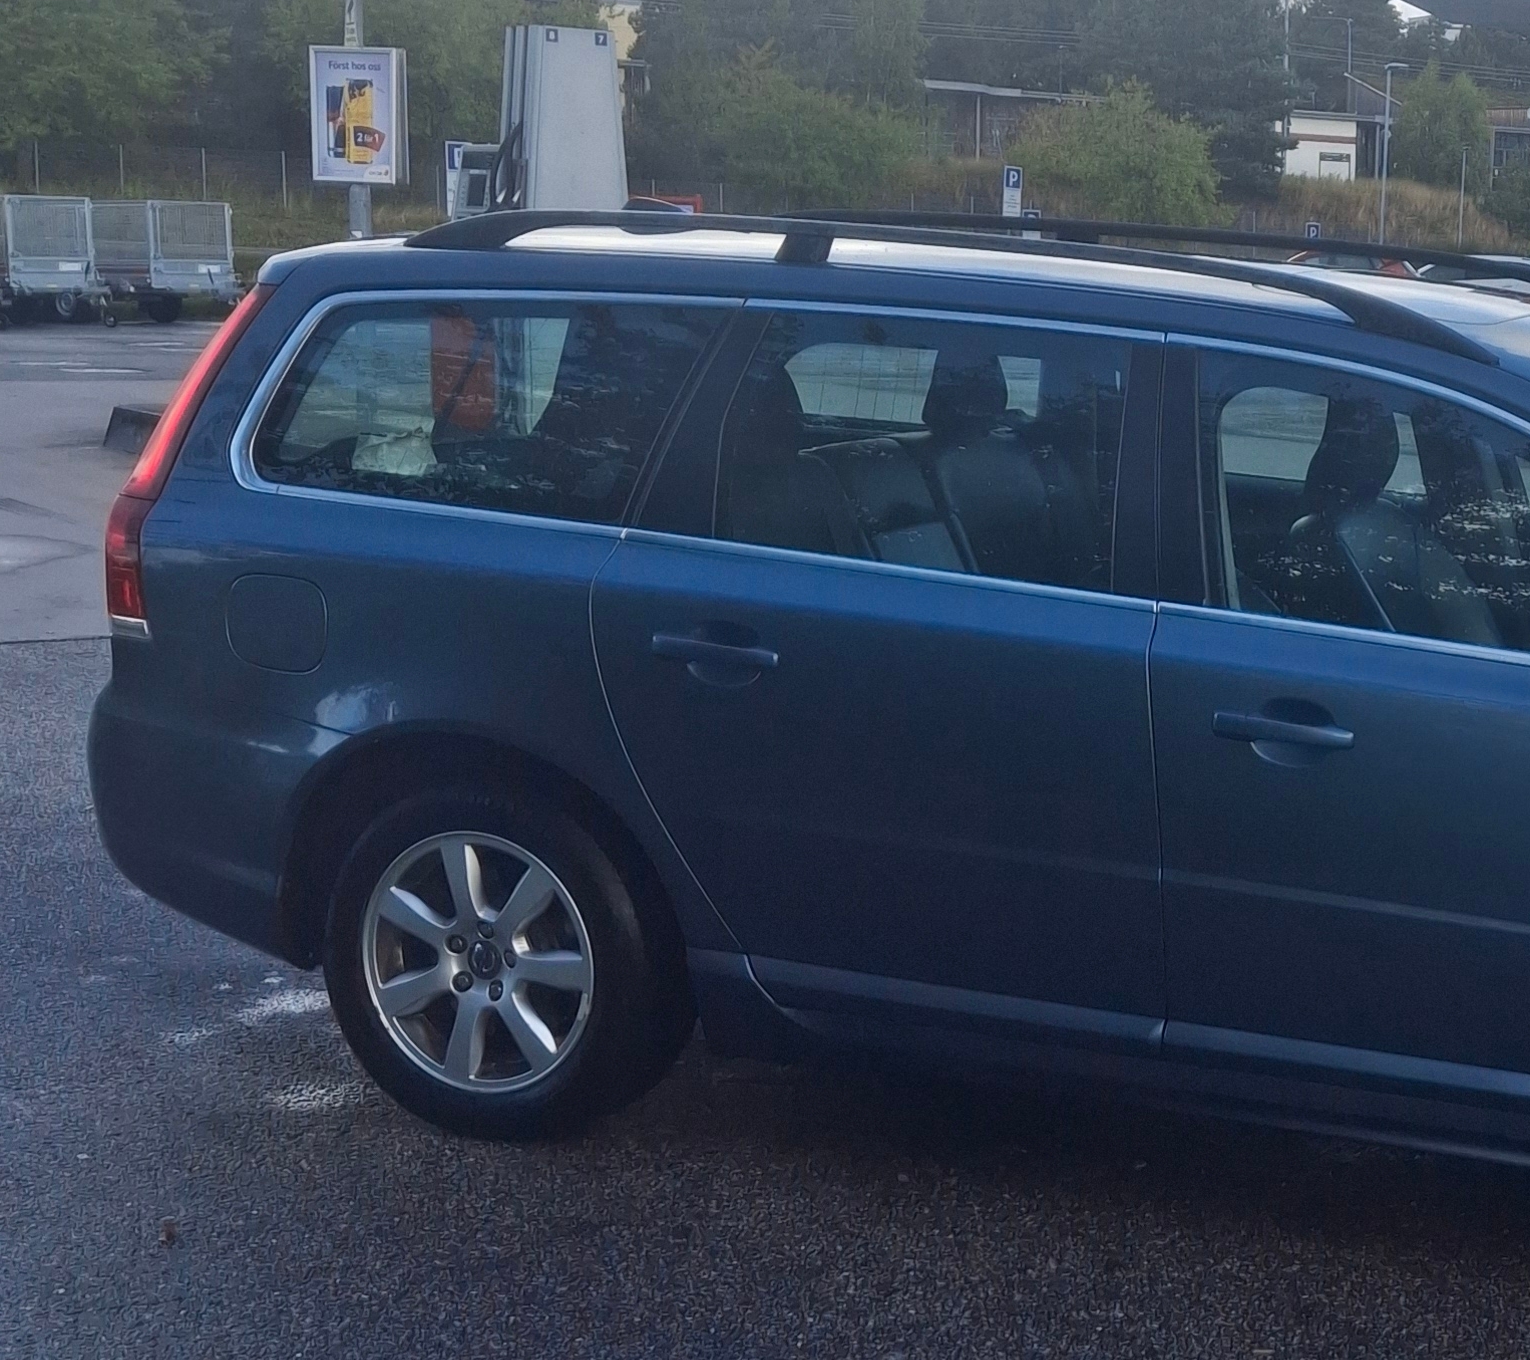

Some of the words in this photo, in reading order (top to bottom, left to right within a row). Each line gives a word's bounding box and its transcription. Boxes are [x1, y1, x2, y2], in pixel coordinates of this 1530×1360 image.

[597, 34, 605, 44] 7
[328, 60, 350, 70] Först
[351, 61, 366, 70] hos
[367, 63, 381, 71] oss
[356, 132, 363, 142] 2
[1009, 170, 1019, 187] P
[1310, 226, 1318, 239] P
